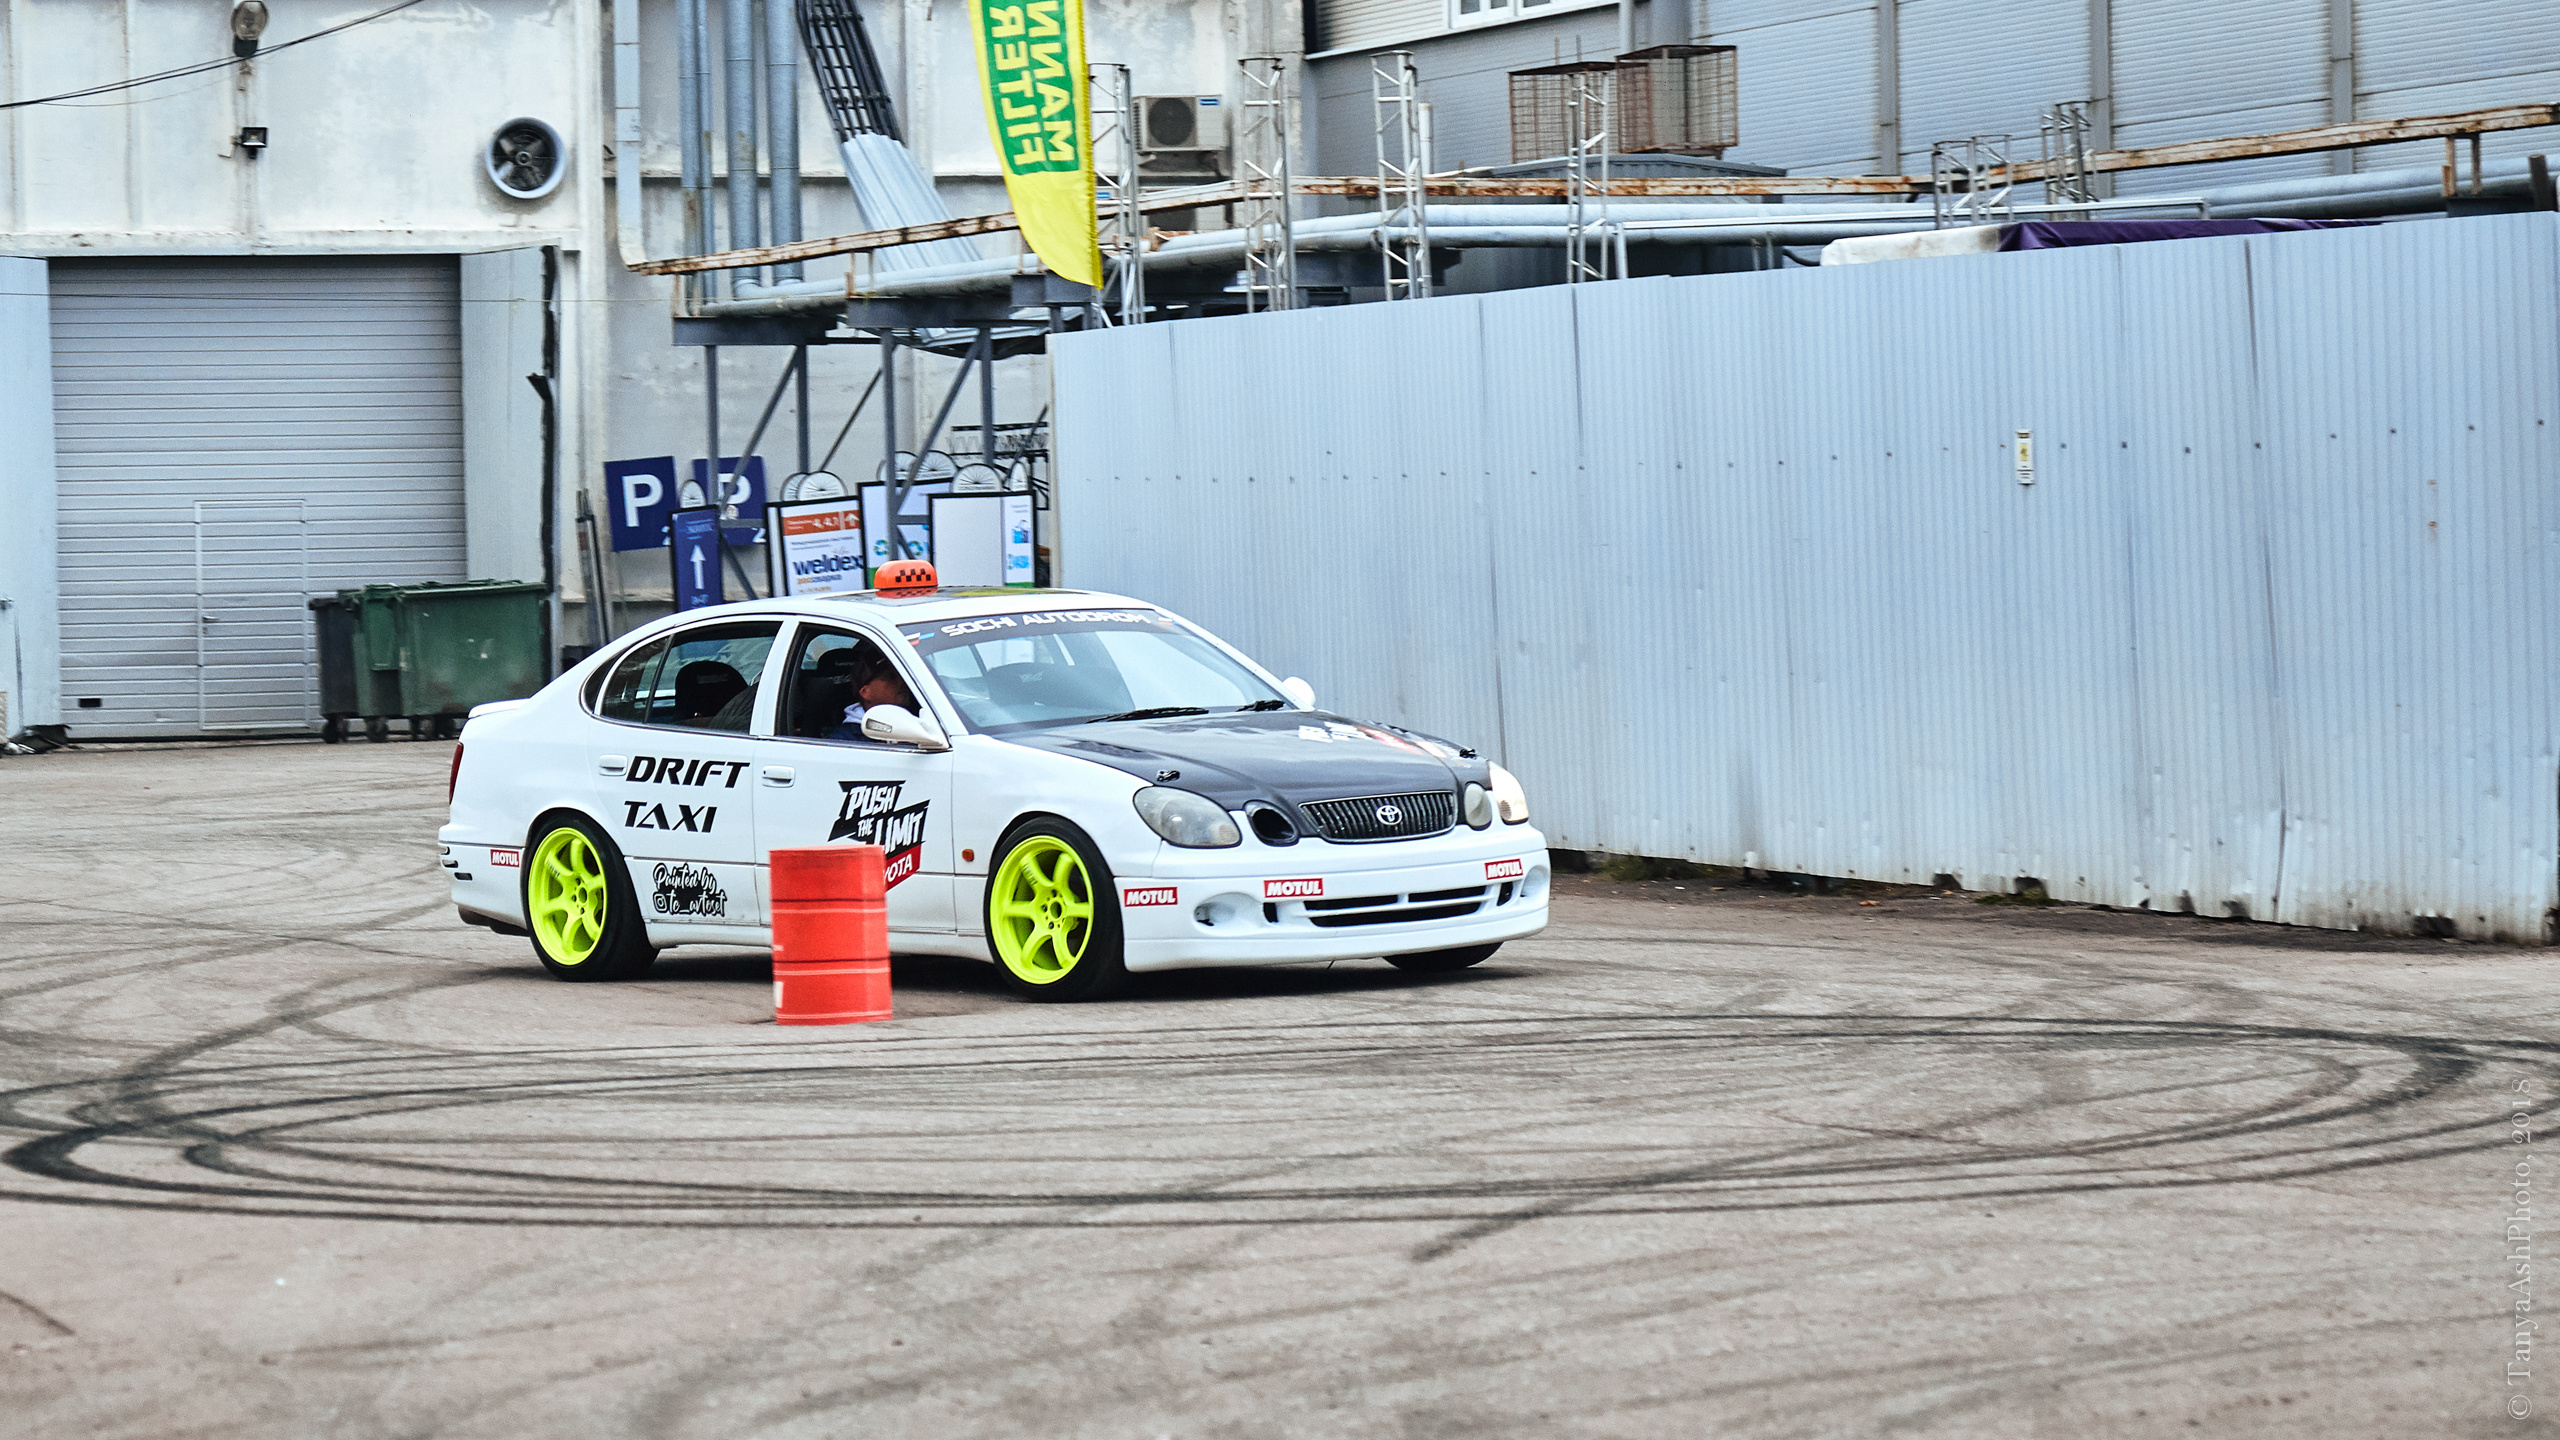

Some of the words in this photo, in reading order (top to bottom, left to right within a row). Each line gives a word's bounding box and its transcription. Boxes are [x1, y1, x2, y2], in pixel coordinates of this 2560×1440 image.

[622, 474, 663, 527] P
[792, 553, 865, 575] weldex
[940, 616, 1018, 637] SOCHI
[1022, 611, 1152, 625] AUTODROM
[625, 755, 751, 789] DRIFT
[624, 800, 718, 833] TAXI
[845, 785, 897, 821] PUSH
[857, 817, 875, 838] THE
[873, 811, 925, 855] LIMIT
[492, 851, 519, 866] MOTUL
[1487, 860, 1522, 879] MOTUL
[653, 863, 699, 891] Painted
[700, 866, 717, 896] by
[1266, 880, 1322, 897] MOTUL
[1126, 889, 1177, 906] MOTUL
